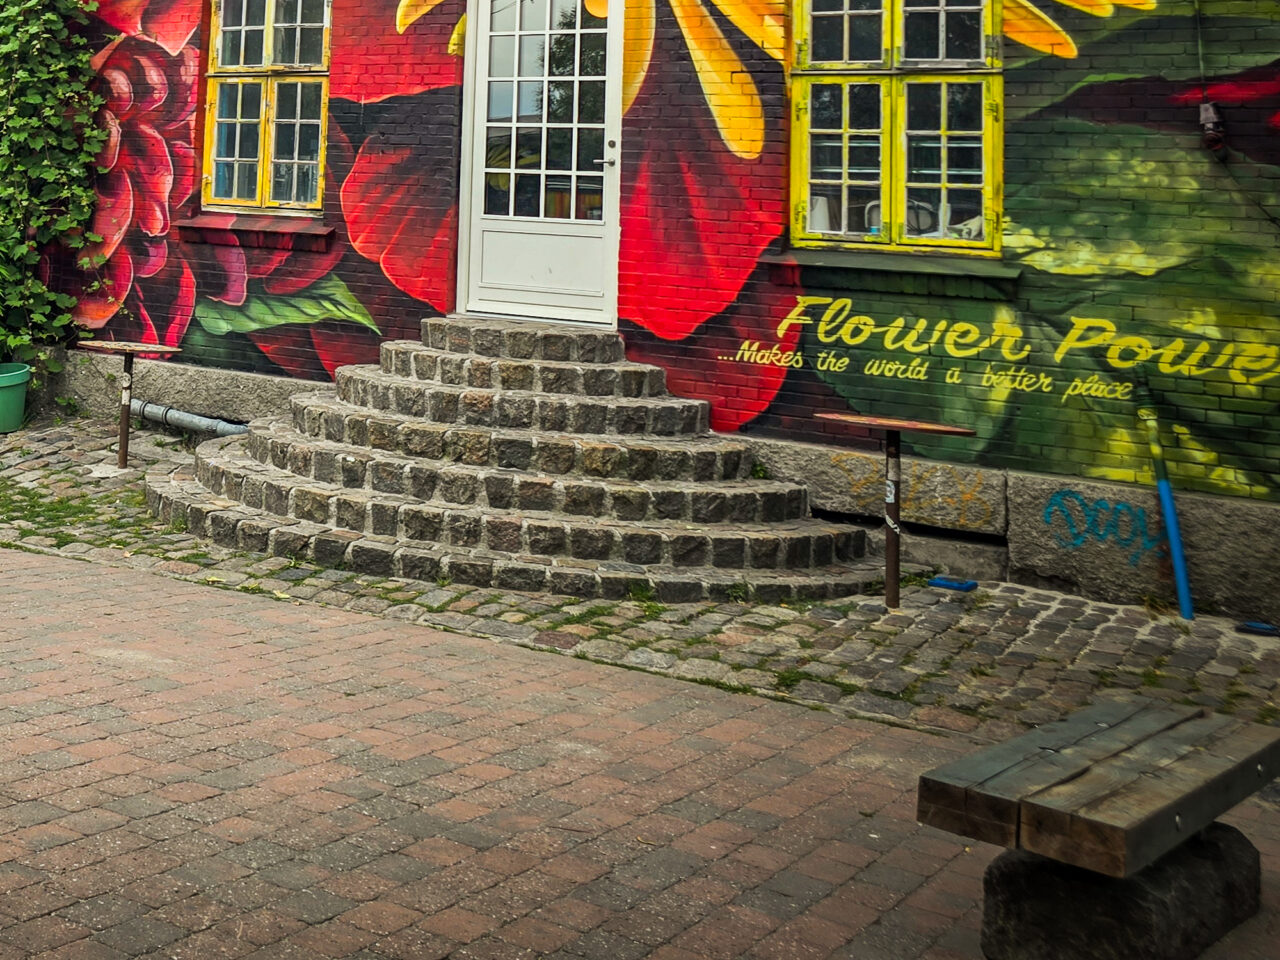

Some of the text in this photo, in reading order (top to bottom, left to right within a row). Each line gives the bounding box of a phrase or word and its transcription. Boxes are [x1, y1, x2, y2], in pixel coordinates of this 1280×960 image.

[776, 295, 1031, 361] Flower
[816, 350, 850, 372] the
[863, 358, 929, 381] world
[945, 371, 963, 384] a
[981, 365, 1053, 392] better
[1061, 374, 1134, 404] place
